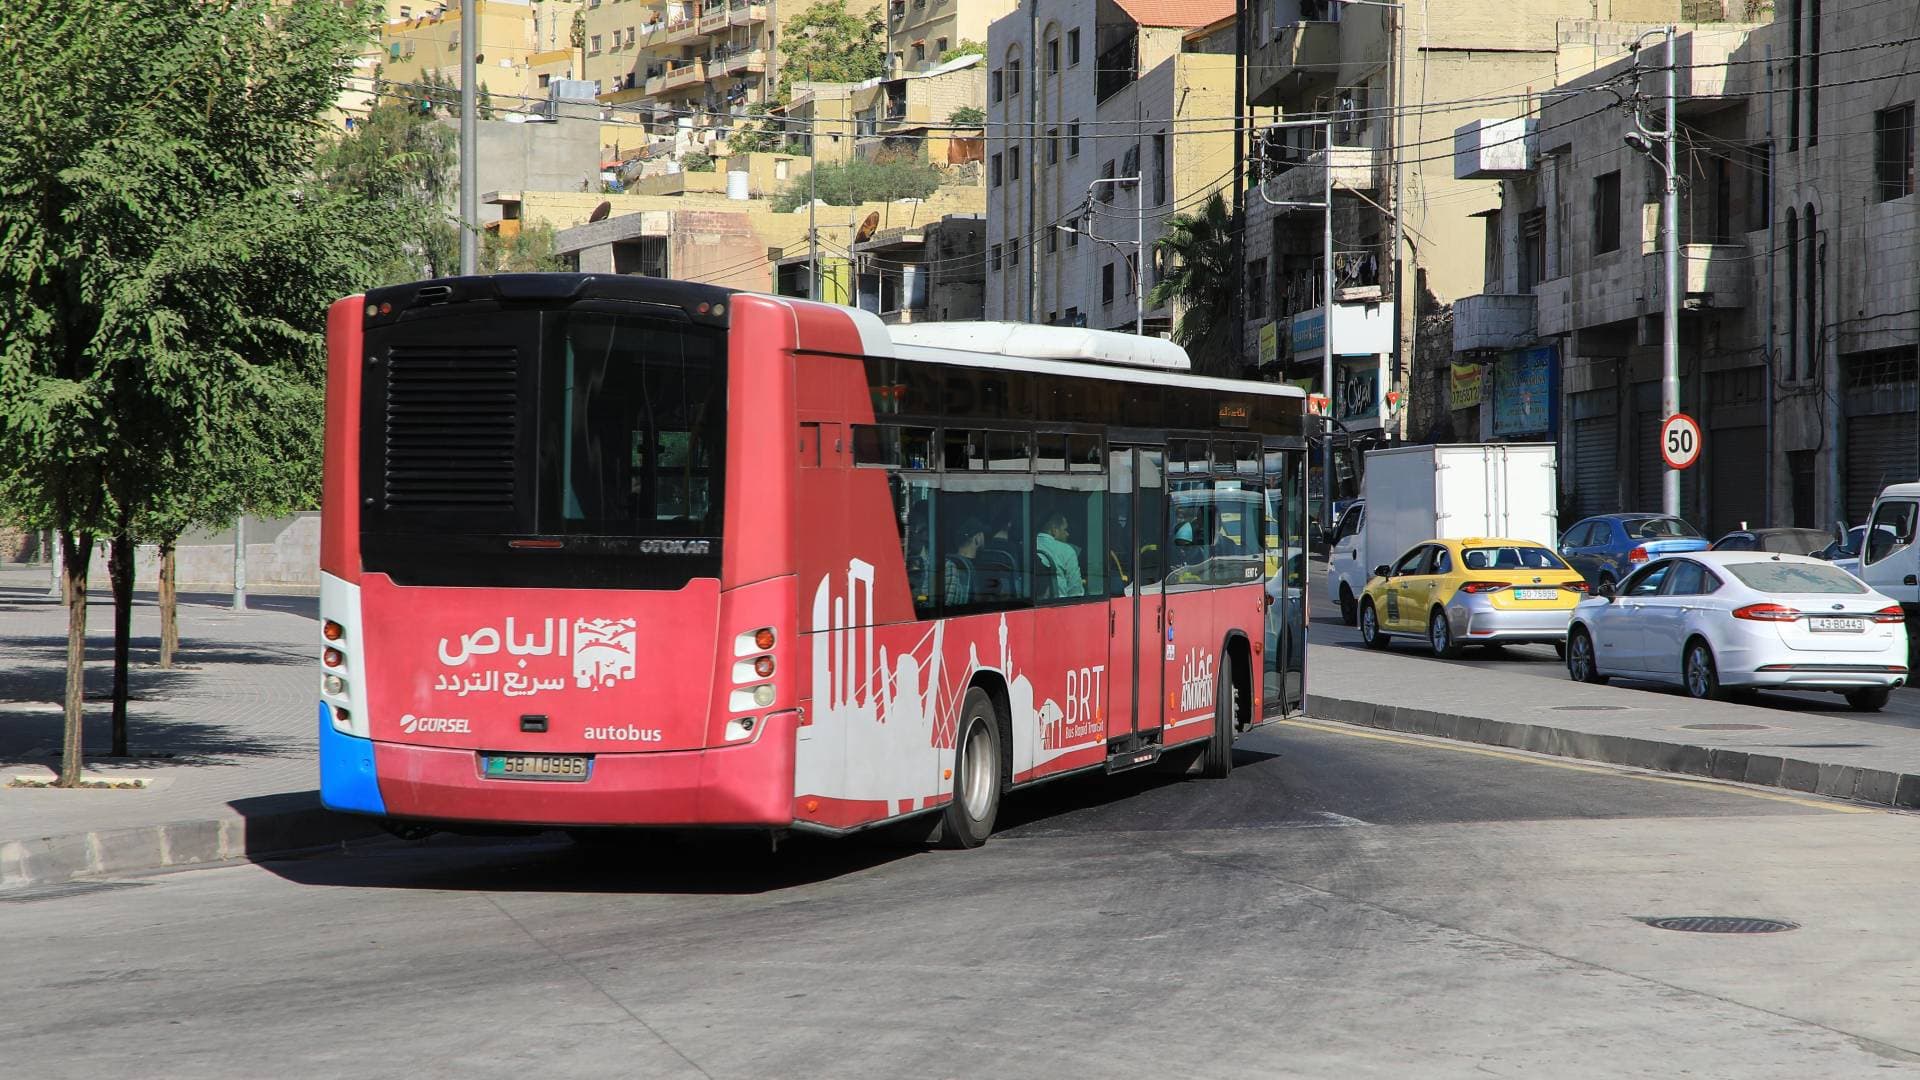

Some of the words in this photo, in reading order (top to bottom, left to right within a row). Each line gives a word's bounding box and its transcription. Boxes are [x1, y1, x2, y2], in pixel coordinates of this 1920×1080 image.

[1668, 429, 1693, 453] 50
[640, 540, 710, 554] OTOKAR
[438, 616, 568, 668] الباص
[434, 670, 499, 697] التردد
[502, 671, 565, 697] سريع
[1066, 665, 1105, 724] BRT
[1181, 677, 1213, 713] AMMAN
[418, 717, 472, 733] GÜRSEL
[584, 724, 662, 742] autobus
[1065, 726, 1075, 739] Bus
[1074, 722, 1088, 737] Rapid
